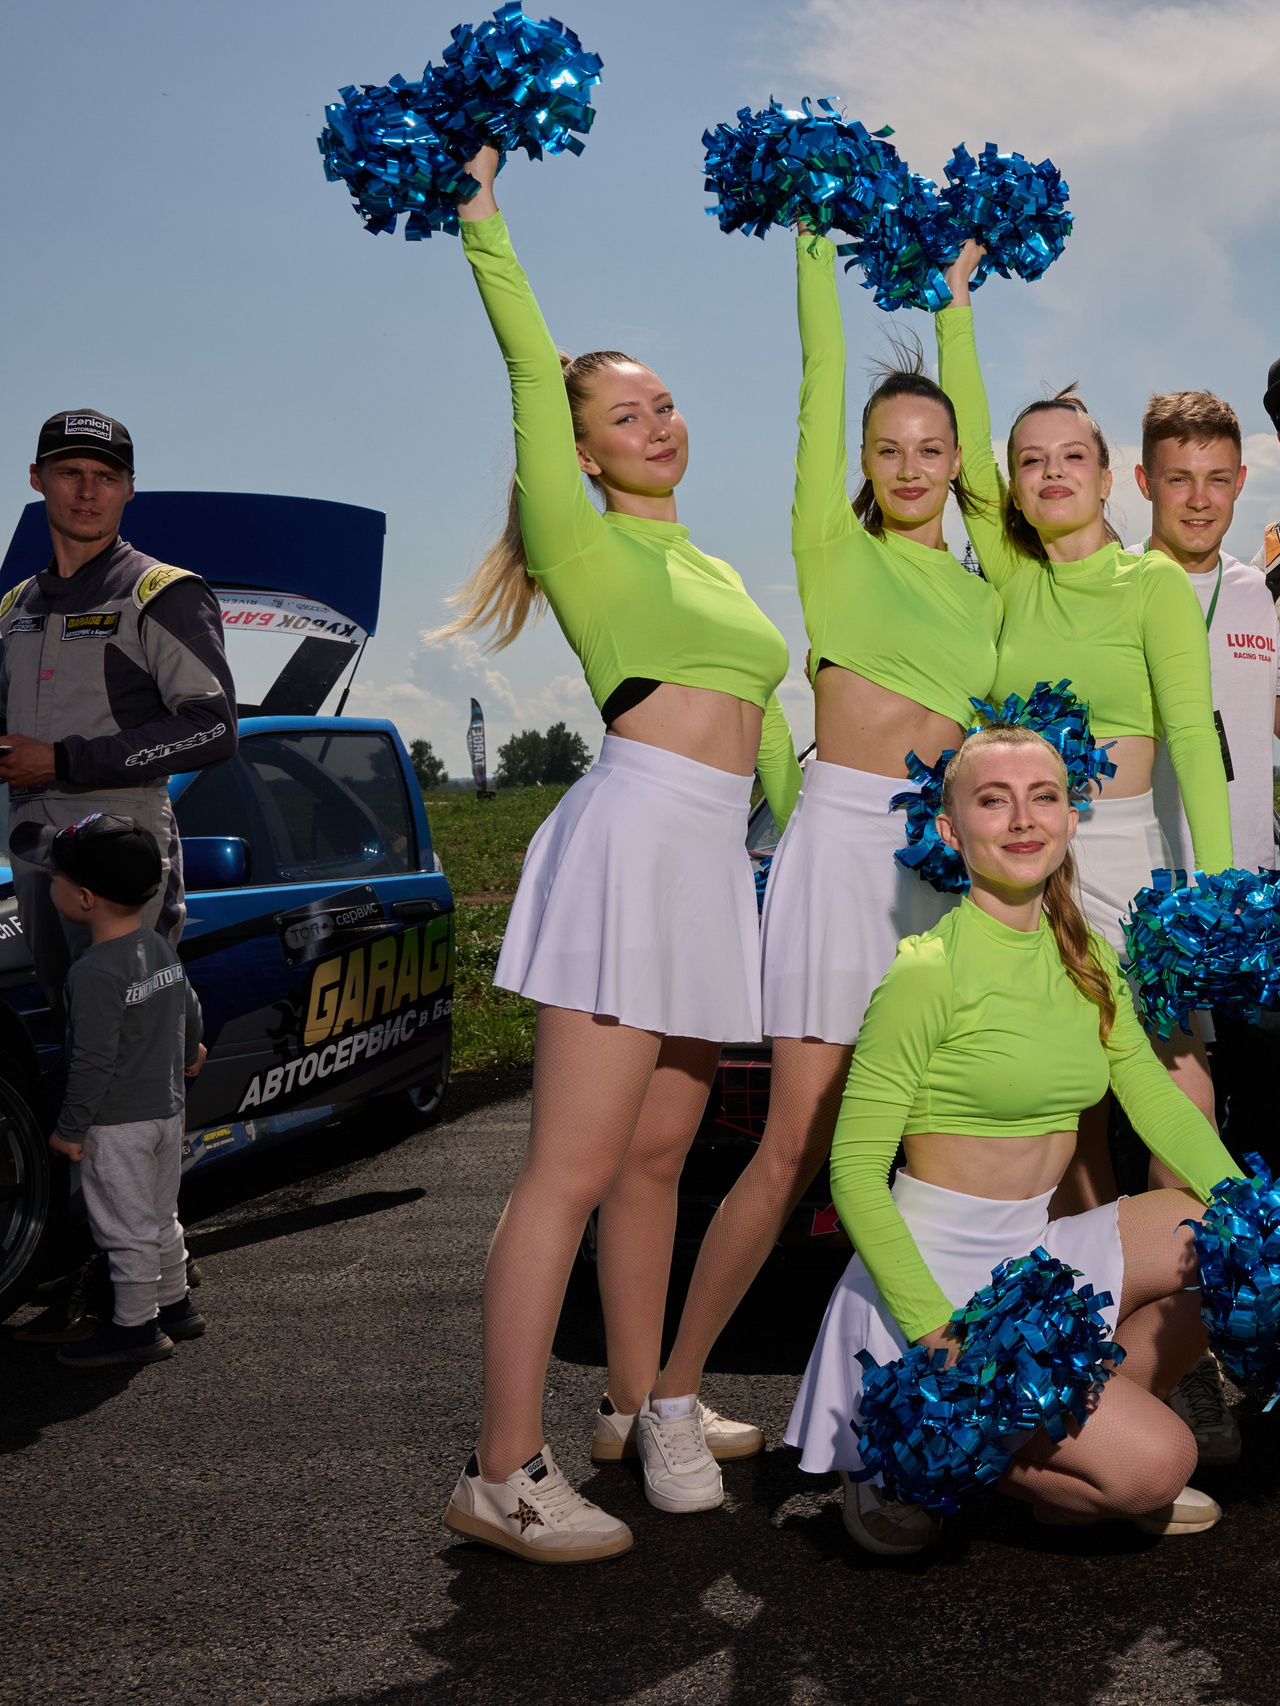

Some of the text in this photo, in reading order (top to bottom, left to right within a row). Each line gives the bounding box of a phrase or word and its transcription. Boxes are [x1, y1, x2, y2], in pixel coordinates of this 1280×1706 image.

[68, 418, 109, 431] Zenich
[68, 427, 109, 437] MOTORSPORT
[67, 615, 103, 628] GARAGE
[276, 614, 358, 638] КУБОК
[1227, 633, 1276, 653] LUKOIL
[1233, 652, 1257, 660] RACING
[124, 722, 227, 767] alpinestars
[291, 902, 379, 943] ТОП сервис
[237, 1009, 418, 1114] АВТОСЕРВИС
[418, 1009, 428, 1027] в
[527, 1458, 544, 1473] GGDB
